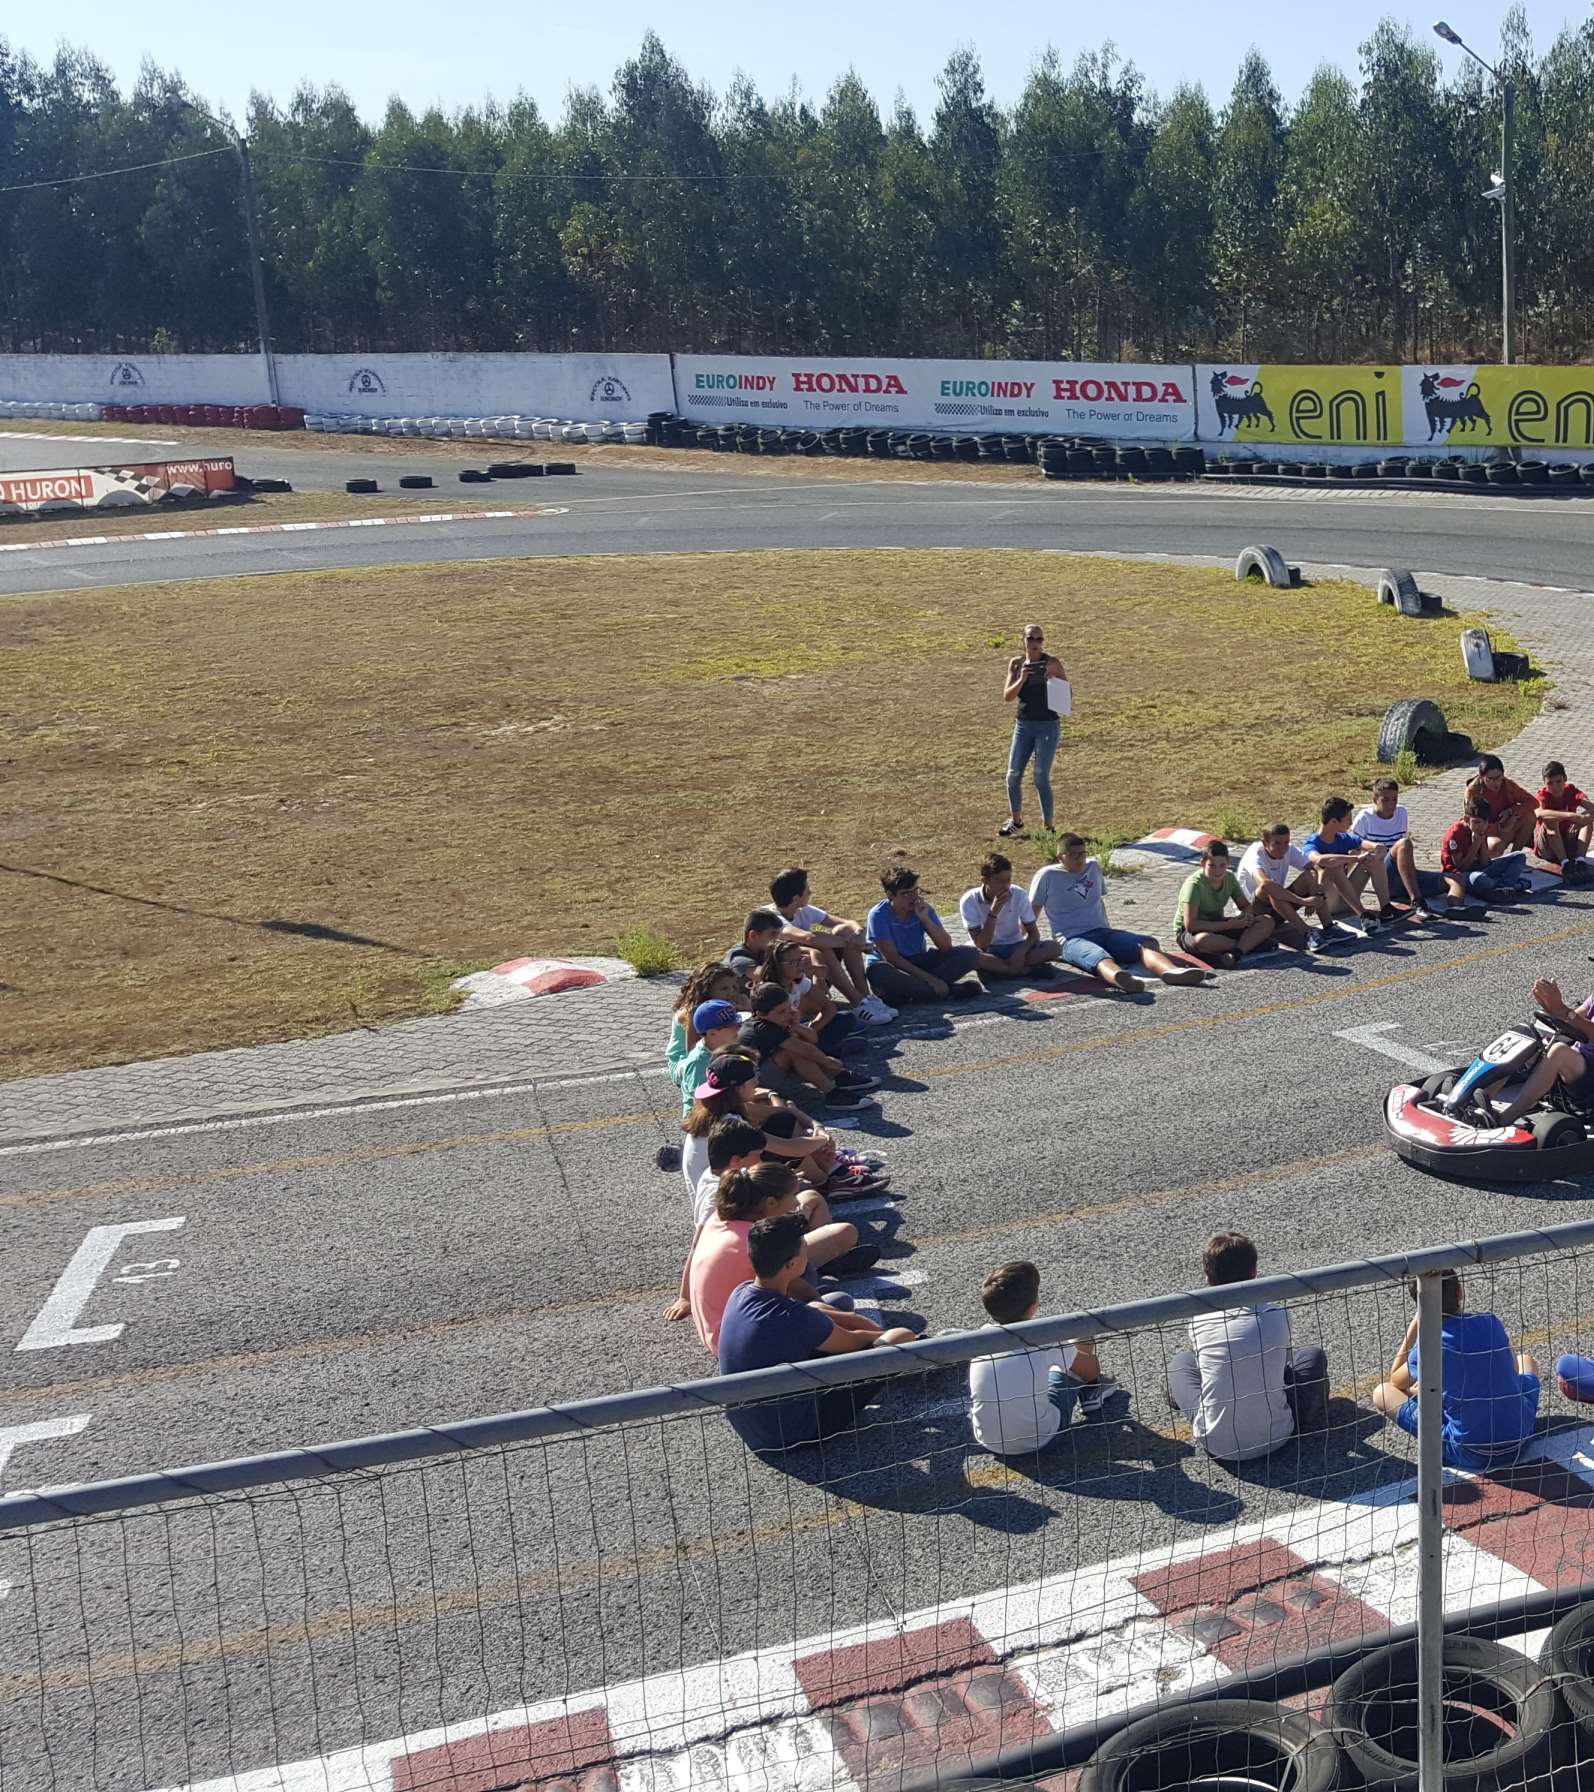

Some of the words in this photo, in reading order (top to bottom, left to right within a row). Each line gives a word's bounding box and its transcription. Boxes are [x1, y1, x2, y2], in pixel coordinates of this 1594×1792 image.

[791, 372, 908, 395] HONDA
[1052, 379, 1187, 403] HONDA
[803, 400, 820, 411] The
[822, 401, 850, 412] Power
[852, 401, 862, 412] of
[864, 402, 899, 413] Dreams
[1004, 408, 1015, 417] em
[1017, 406, 1049, 418] exclusivo
[1066, 408, 1086, 420] The
[1088, 409, 1121, 421] Power
[1123, 411, 1134, 421] of
[1136, 411, 1179, 423] Dreams
[1289, 371, 1388, 441] eni
[11, 478, 87, 501] HURON
[1489, 1036, 1521, 1057] 64
